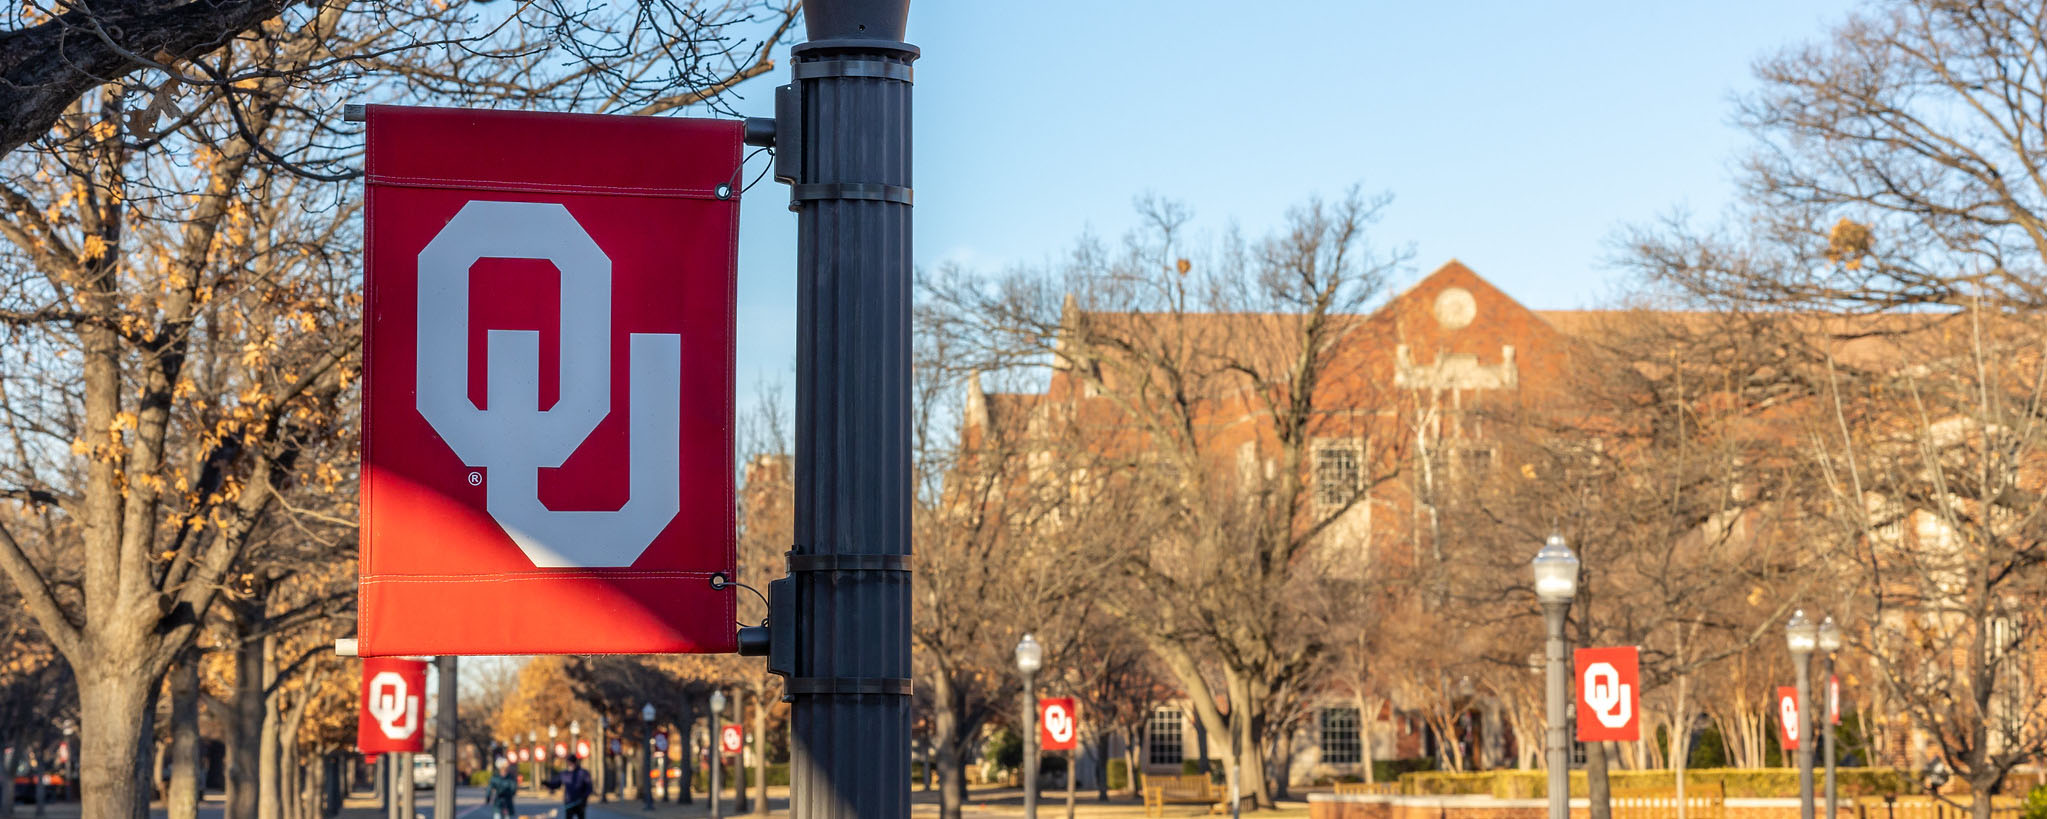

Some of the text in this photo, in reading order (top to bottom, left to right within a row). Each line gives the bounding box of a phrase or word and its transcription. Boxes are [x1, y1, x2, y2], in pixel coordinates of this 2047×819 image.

[416, 200, 681, 567] OU
[369, 671, 419, 740] OU
[1584, 662, 1632, 728] OU
